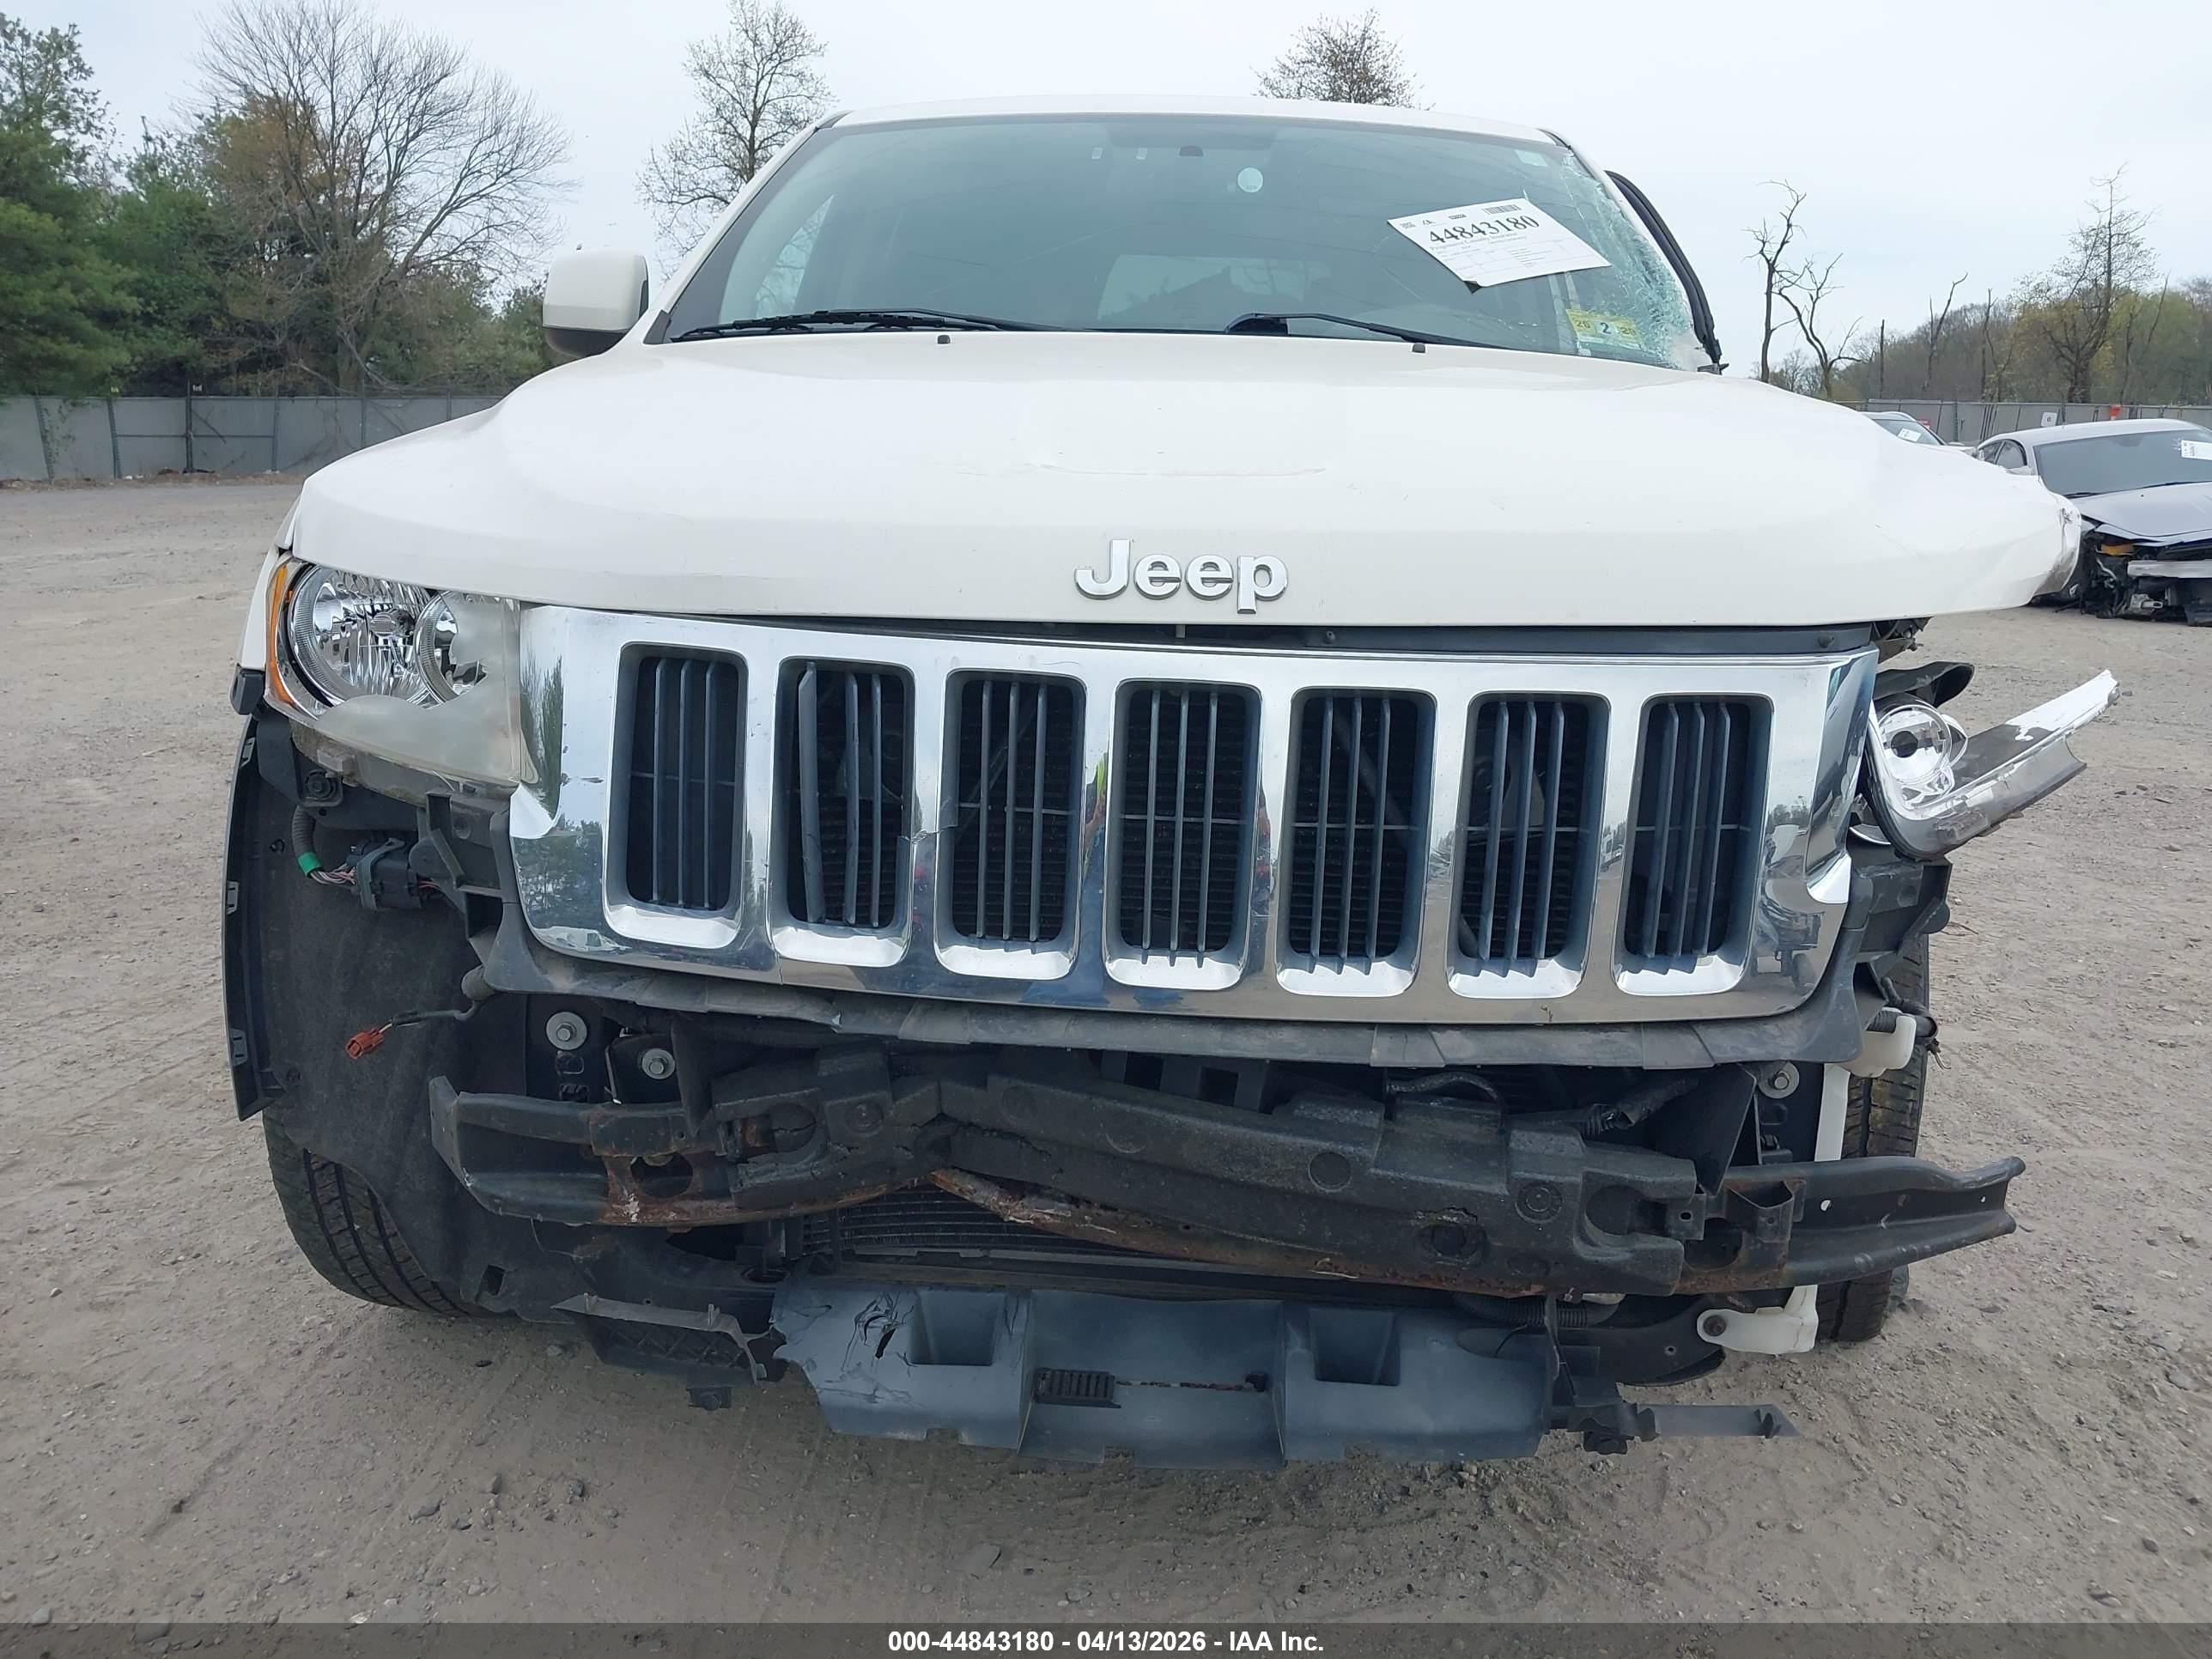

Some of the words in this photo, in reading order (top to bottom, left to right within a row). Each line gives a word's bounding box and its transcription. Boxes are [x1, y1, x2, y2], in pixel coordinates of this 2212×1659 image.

[1430, 216, 1540, 243] 44843180
[1600, 322, 1611, 334] 2
[1073, 538, 1288, 615] Jeep
